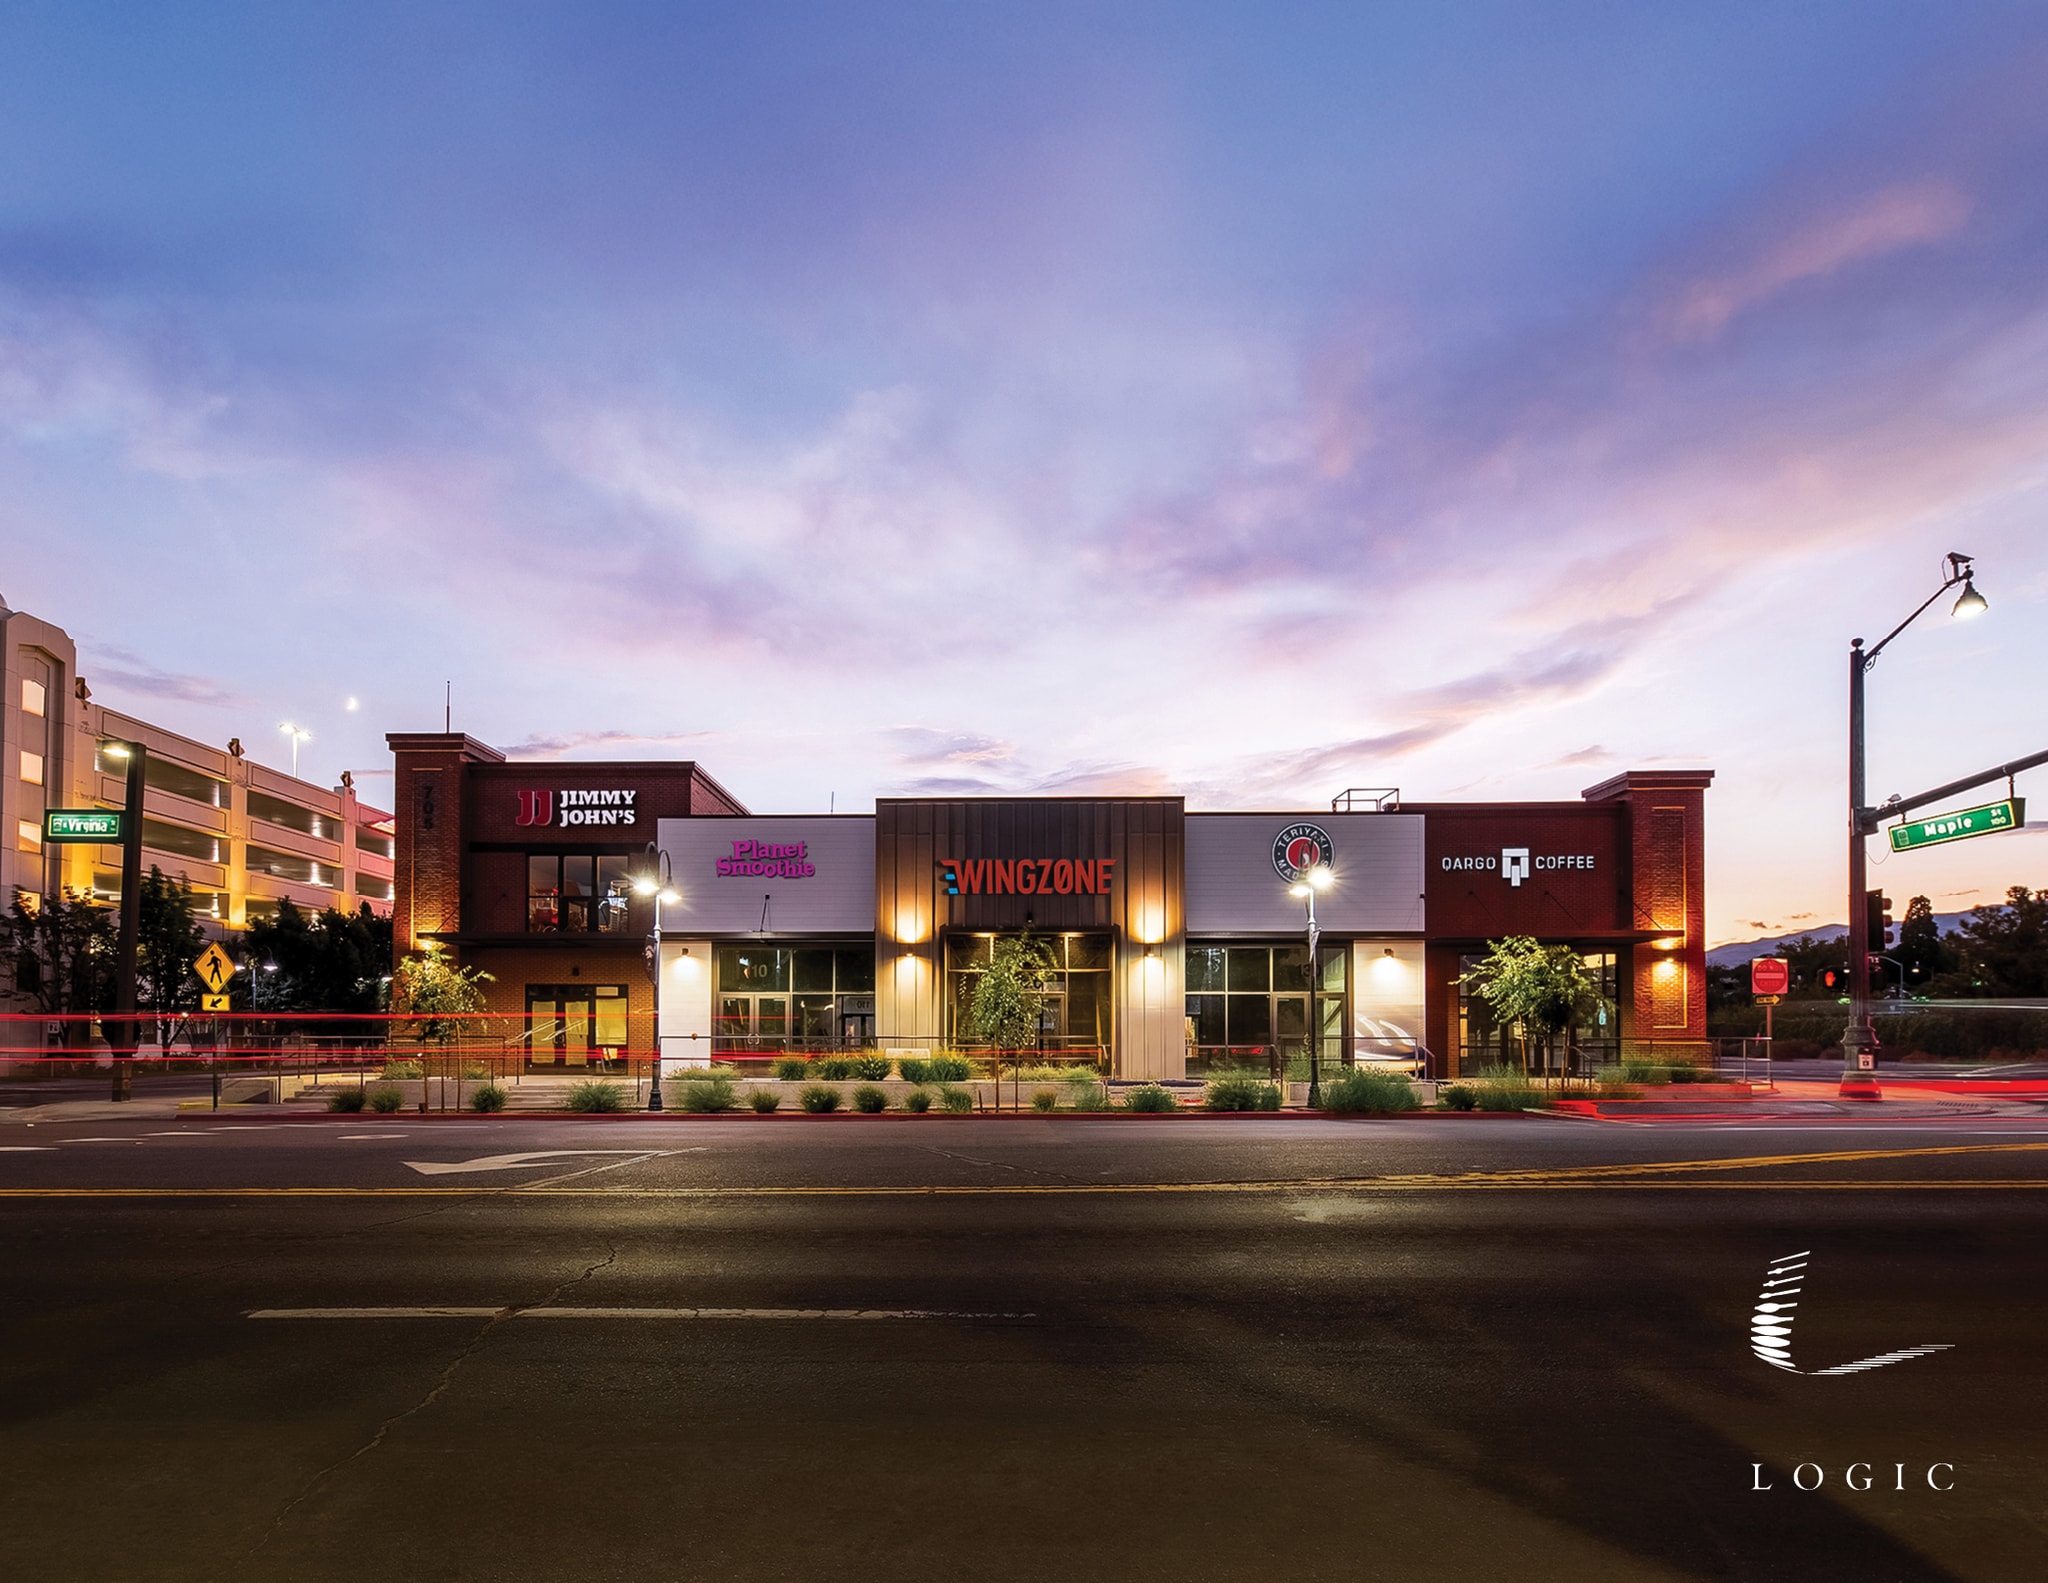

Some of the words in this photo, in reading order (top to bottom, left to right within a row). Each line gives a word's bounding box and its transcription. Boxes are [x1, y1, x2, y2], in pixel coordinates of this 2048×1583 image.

[560, 790, 636, 808] JIMMY
[560, 809, 636, 827] JOHN'S
[1990, 808, 2002, 817] St
[68, 818, 108, 833] Virginia
[1923, 817, 1973, 837] Maple
[1277, 827, 1329, 849] TERIYAKI
[731, 839, 808, 860] Planet
[716, 857, 815, 878] Smoothie
[1277, 859, 1329, 884] MADS
[1442, 857, 1496, 871] QARGO
[1535, 856, 1595, 869] COFFEE
